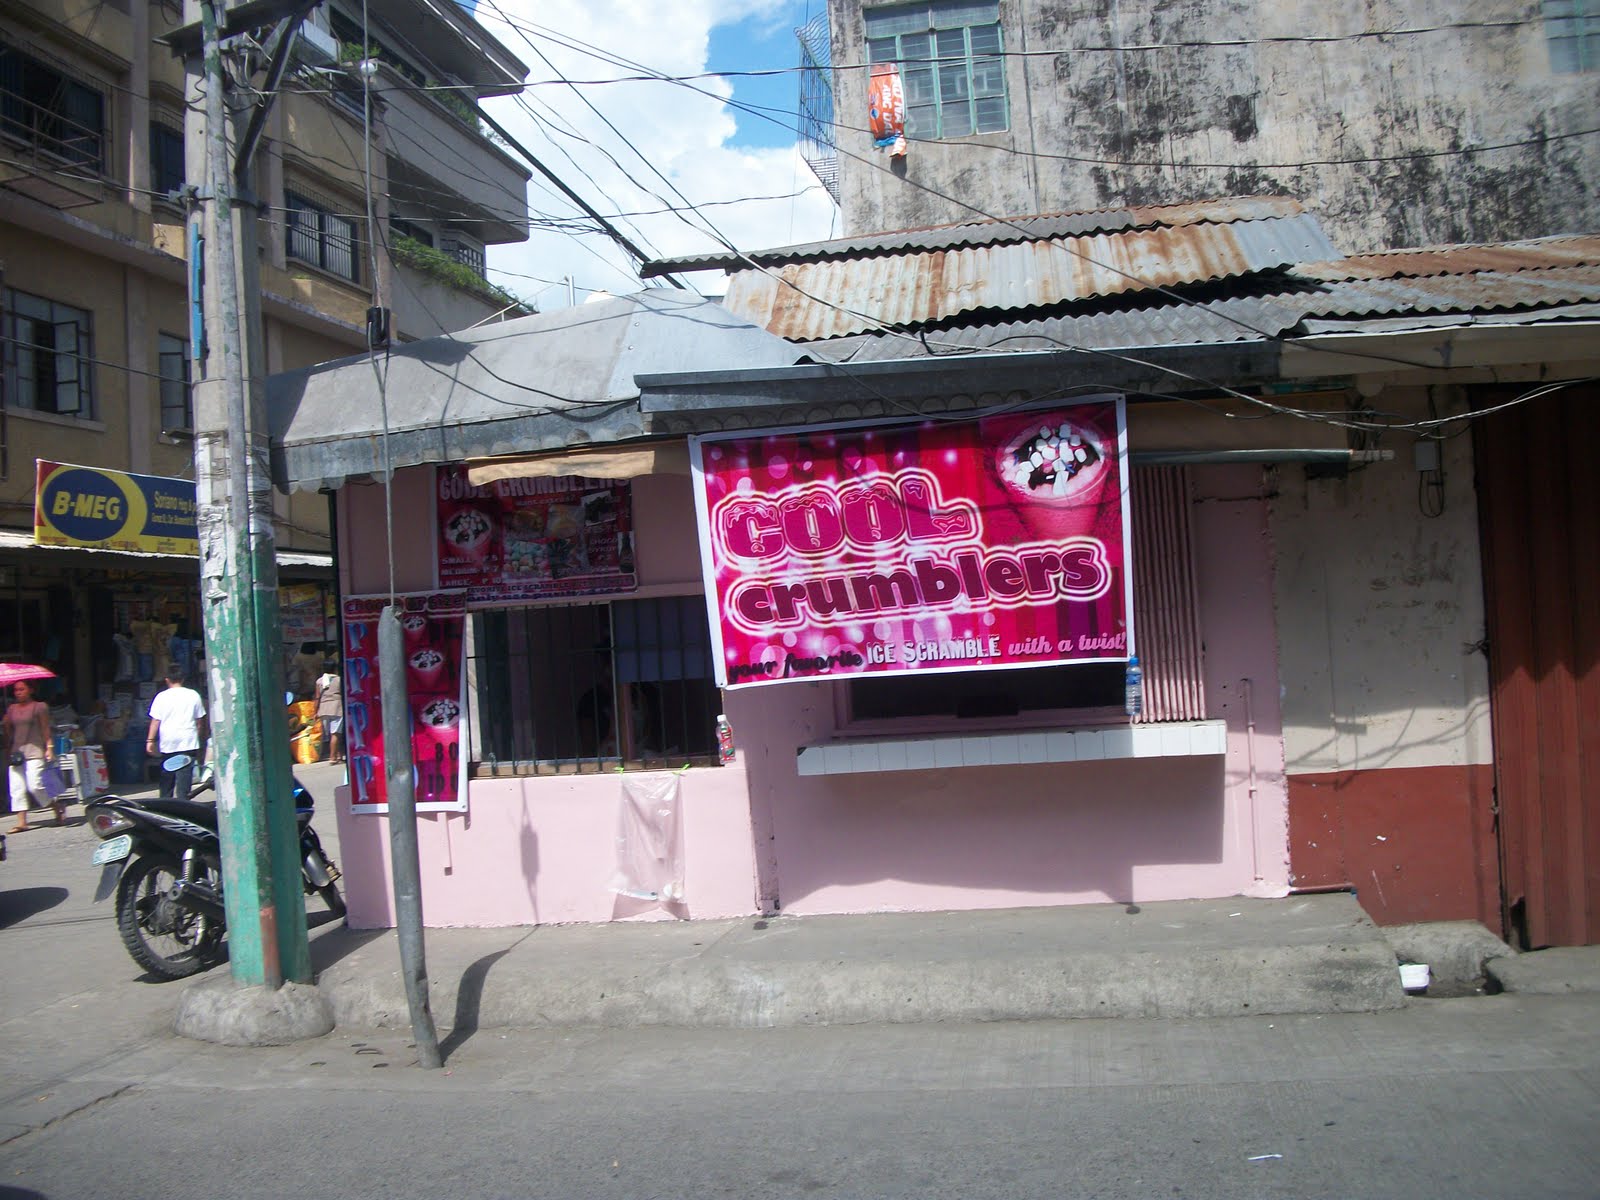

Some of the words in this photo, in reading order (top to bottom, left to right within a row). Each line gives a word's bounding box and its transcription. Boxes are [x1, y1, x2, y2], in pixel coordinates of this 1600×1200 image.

[52, 491, 121, 521] B-MEG
[723, 478, 972, 559] COOL
[736, 549, 1101, 623] crumblers
[867, 640, 897, 665] ICE
[903, 634, 1002, 665] SCRAMBLE
[1008, 635, 1053, 656] with
[1056, 639, 1074, 653] a
